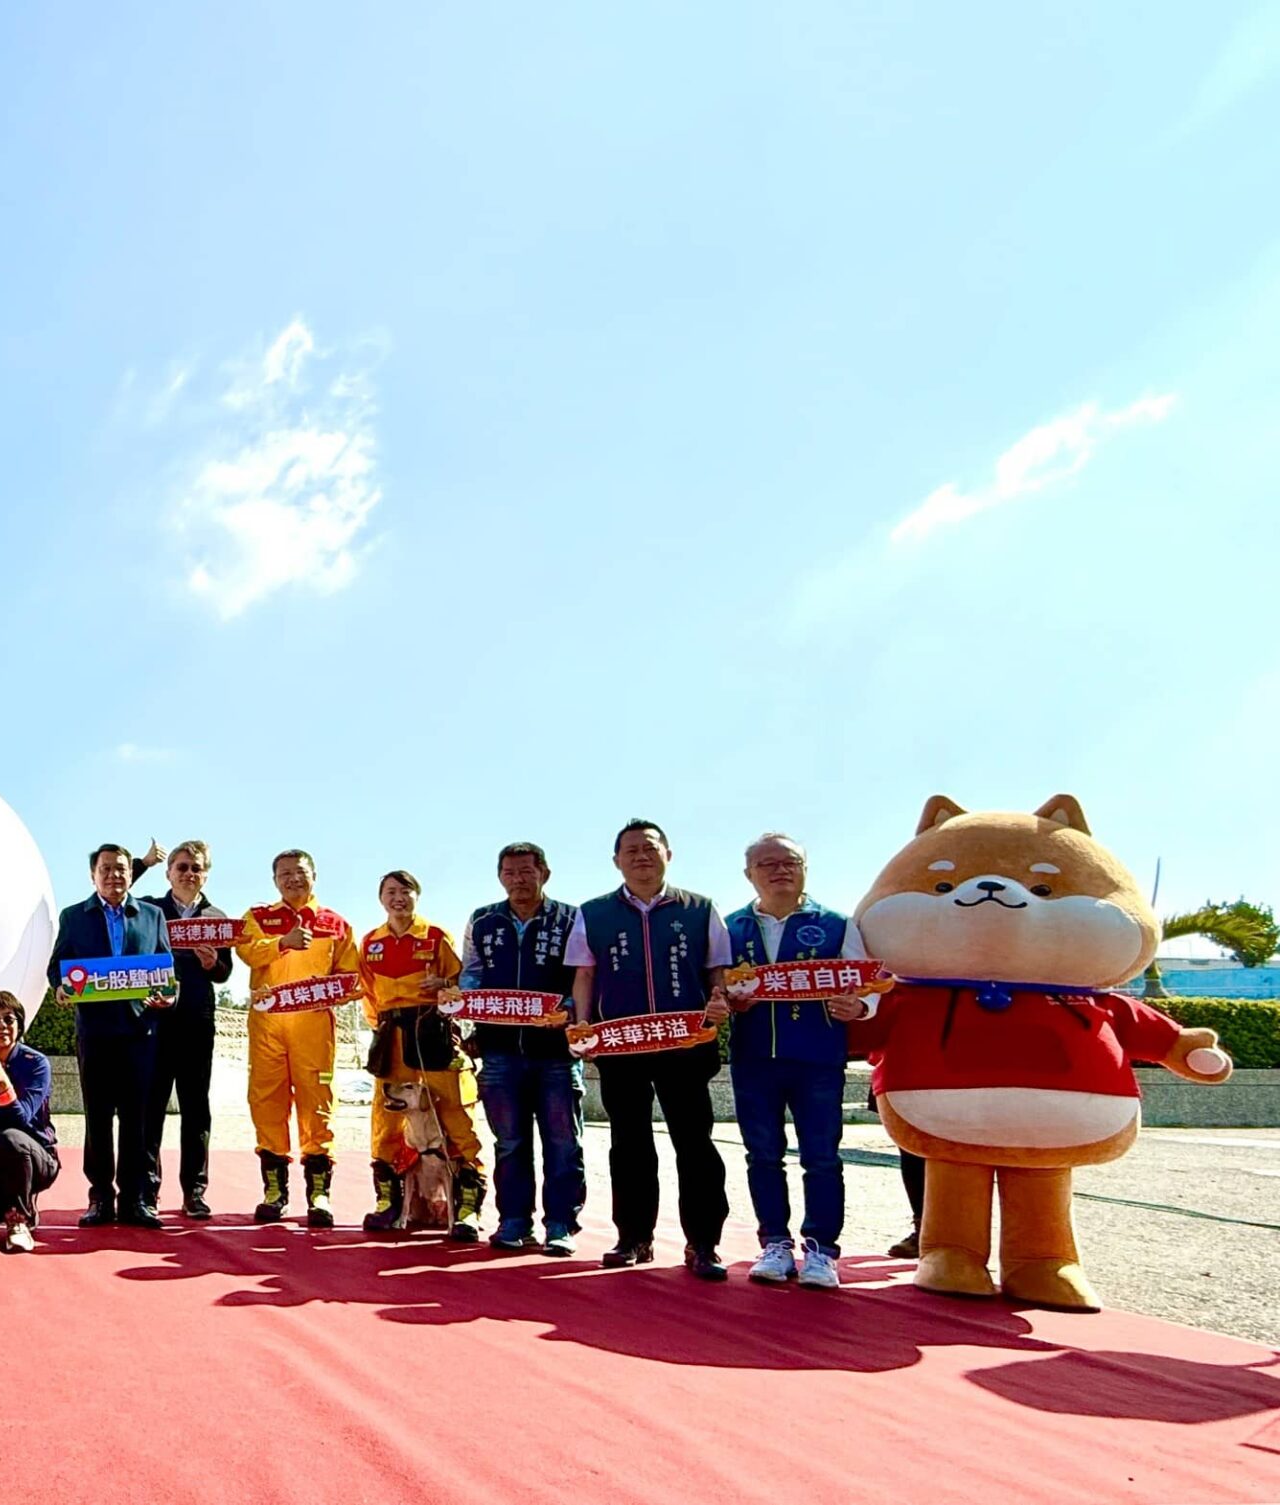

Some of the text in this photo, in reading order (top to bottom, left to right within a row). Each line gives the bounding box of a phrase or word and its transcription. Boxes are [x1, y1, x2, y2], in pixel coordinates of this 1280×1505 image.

[170, 922, 234, 941] 柴德兼備
[90, 967, 170, 990] 七股鹽山
[763, 965, 863, 992] 柴富自由
[278, 980, 345, 1008] 真柴實料
[467, 996, 544, 1016] 神柴飛揚
[601, 1018, 690, 1048] 柴華洋溢
